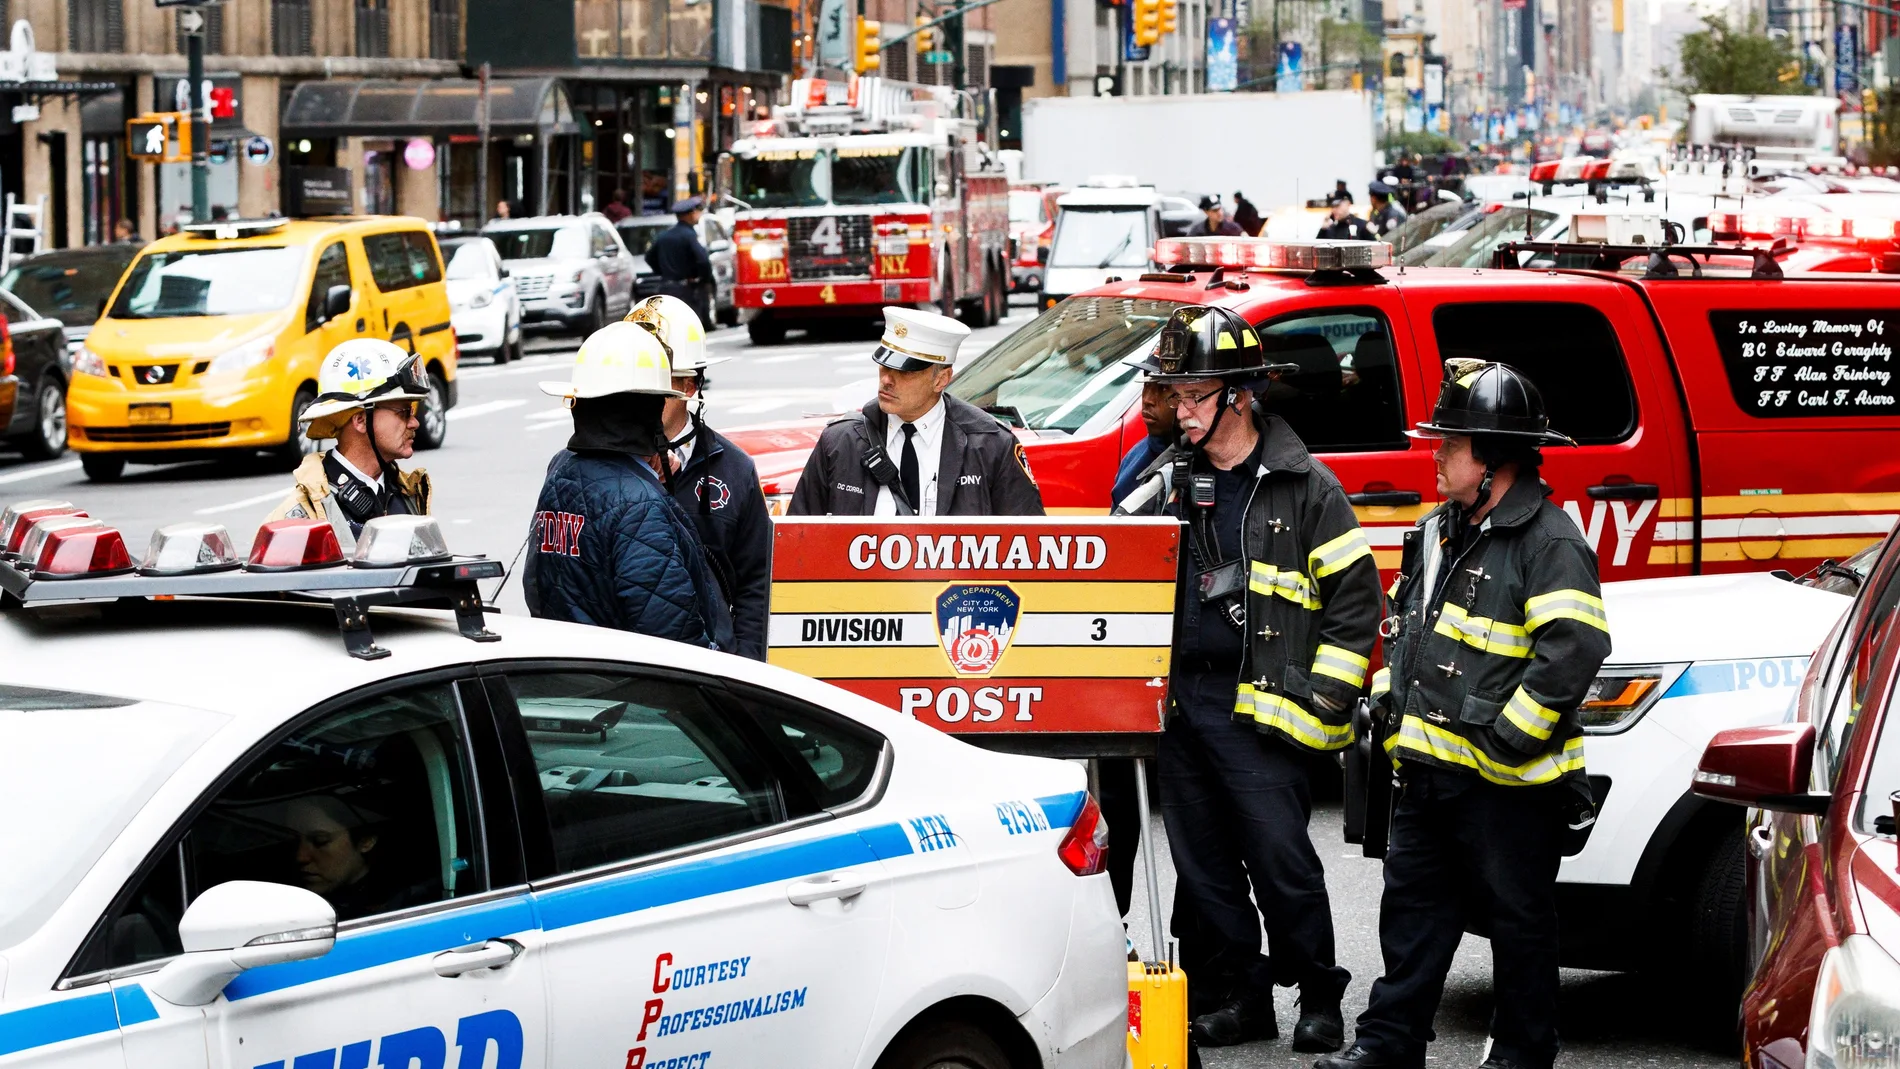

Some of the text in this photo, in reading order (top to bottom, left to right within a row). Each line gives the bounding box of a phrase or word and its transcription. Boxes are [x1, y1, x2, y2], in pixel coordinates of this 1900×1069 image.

[811, 217, 843, 255] 4
[881, 255, 910, 274] N.Y.
[819, 285, 837, 303] 4
[1323, 321, 1378, 337] POLICE
[1739, 319, 1884, 338] In Loving Memory Of
[1776, 342, 1826, 357] Edward
[1832, 341, 1892, 362] Geraghty
[1794, 366, 1827, 381] Alan
[1833, 365, 1891, 386] Feinberg
[1798, 390, 1829, 406] Carl
[1833, 389, 1850, 406] F.
[1854, 389, 1896, 406] Asaro
[836, 482, 865, 495] DC CORRA
[956, 474, 982, 486] DNY
[849, 534, 1107, 570] COMMAND
[942, 586, 1015, 608] FIRE DEPARTMENT
[801, 618, 903, 642] DIVISION
[1091, 618, 1107, 641] 3
[1736, 659, 1808, 690] POL
[900, 686, 1043, 723] POST
[908, 813, 957, 853] MTN
[652, 952, 751, 994] COURTESY
[636, 986, 808, 1042] PROFESSIONALISM
[625, 1046, 711, 1069] RPECT
